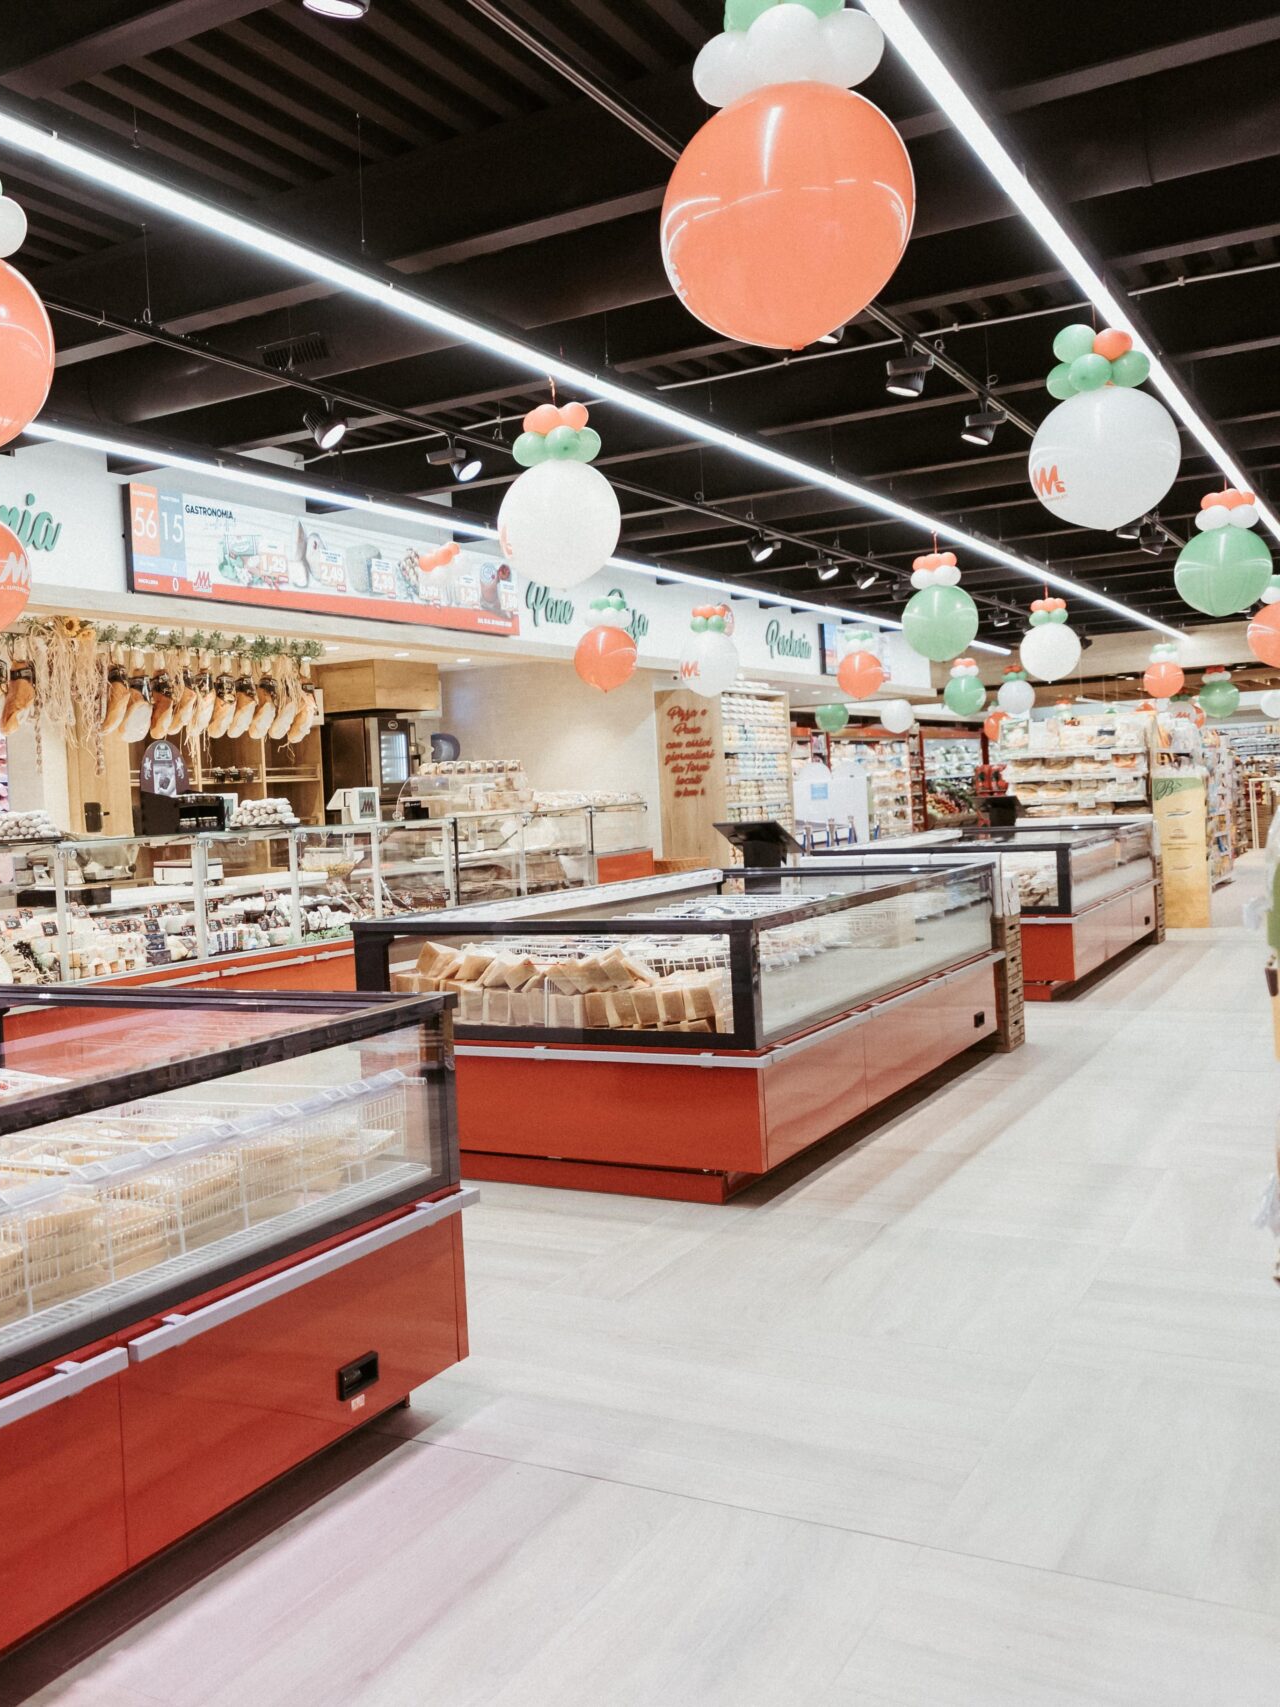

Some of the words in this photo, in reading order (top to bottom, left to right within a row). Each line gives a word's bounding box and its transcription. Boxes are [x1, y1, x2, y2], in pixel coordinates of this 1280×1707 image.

[185, 504, 233, 520] GASTRONOMIA
[134, 507, 157, 539] 56
[162, 512, 183, 543] 15
[172, 577, 179, 592] 0
[667, 706, 697, 721] Pizza
[673, 722, 701, 736] Pane
